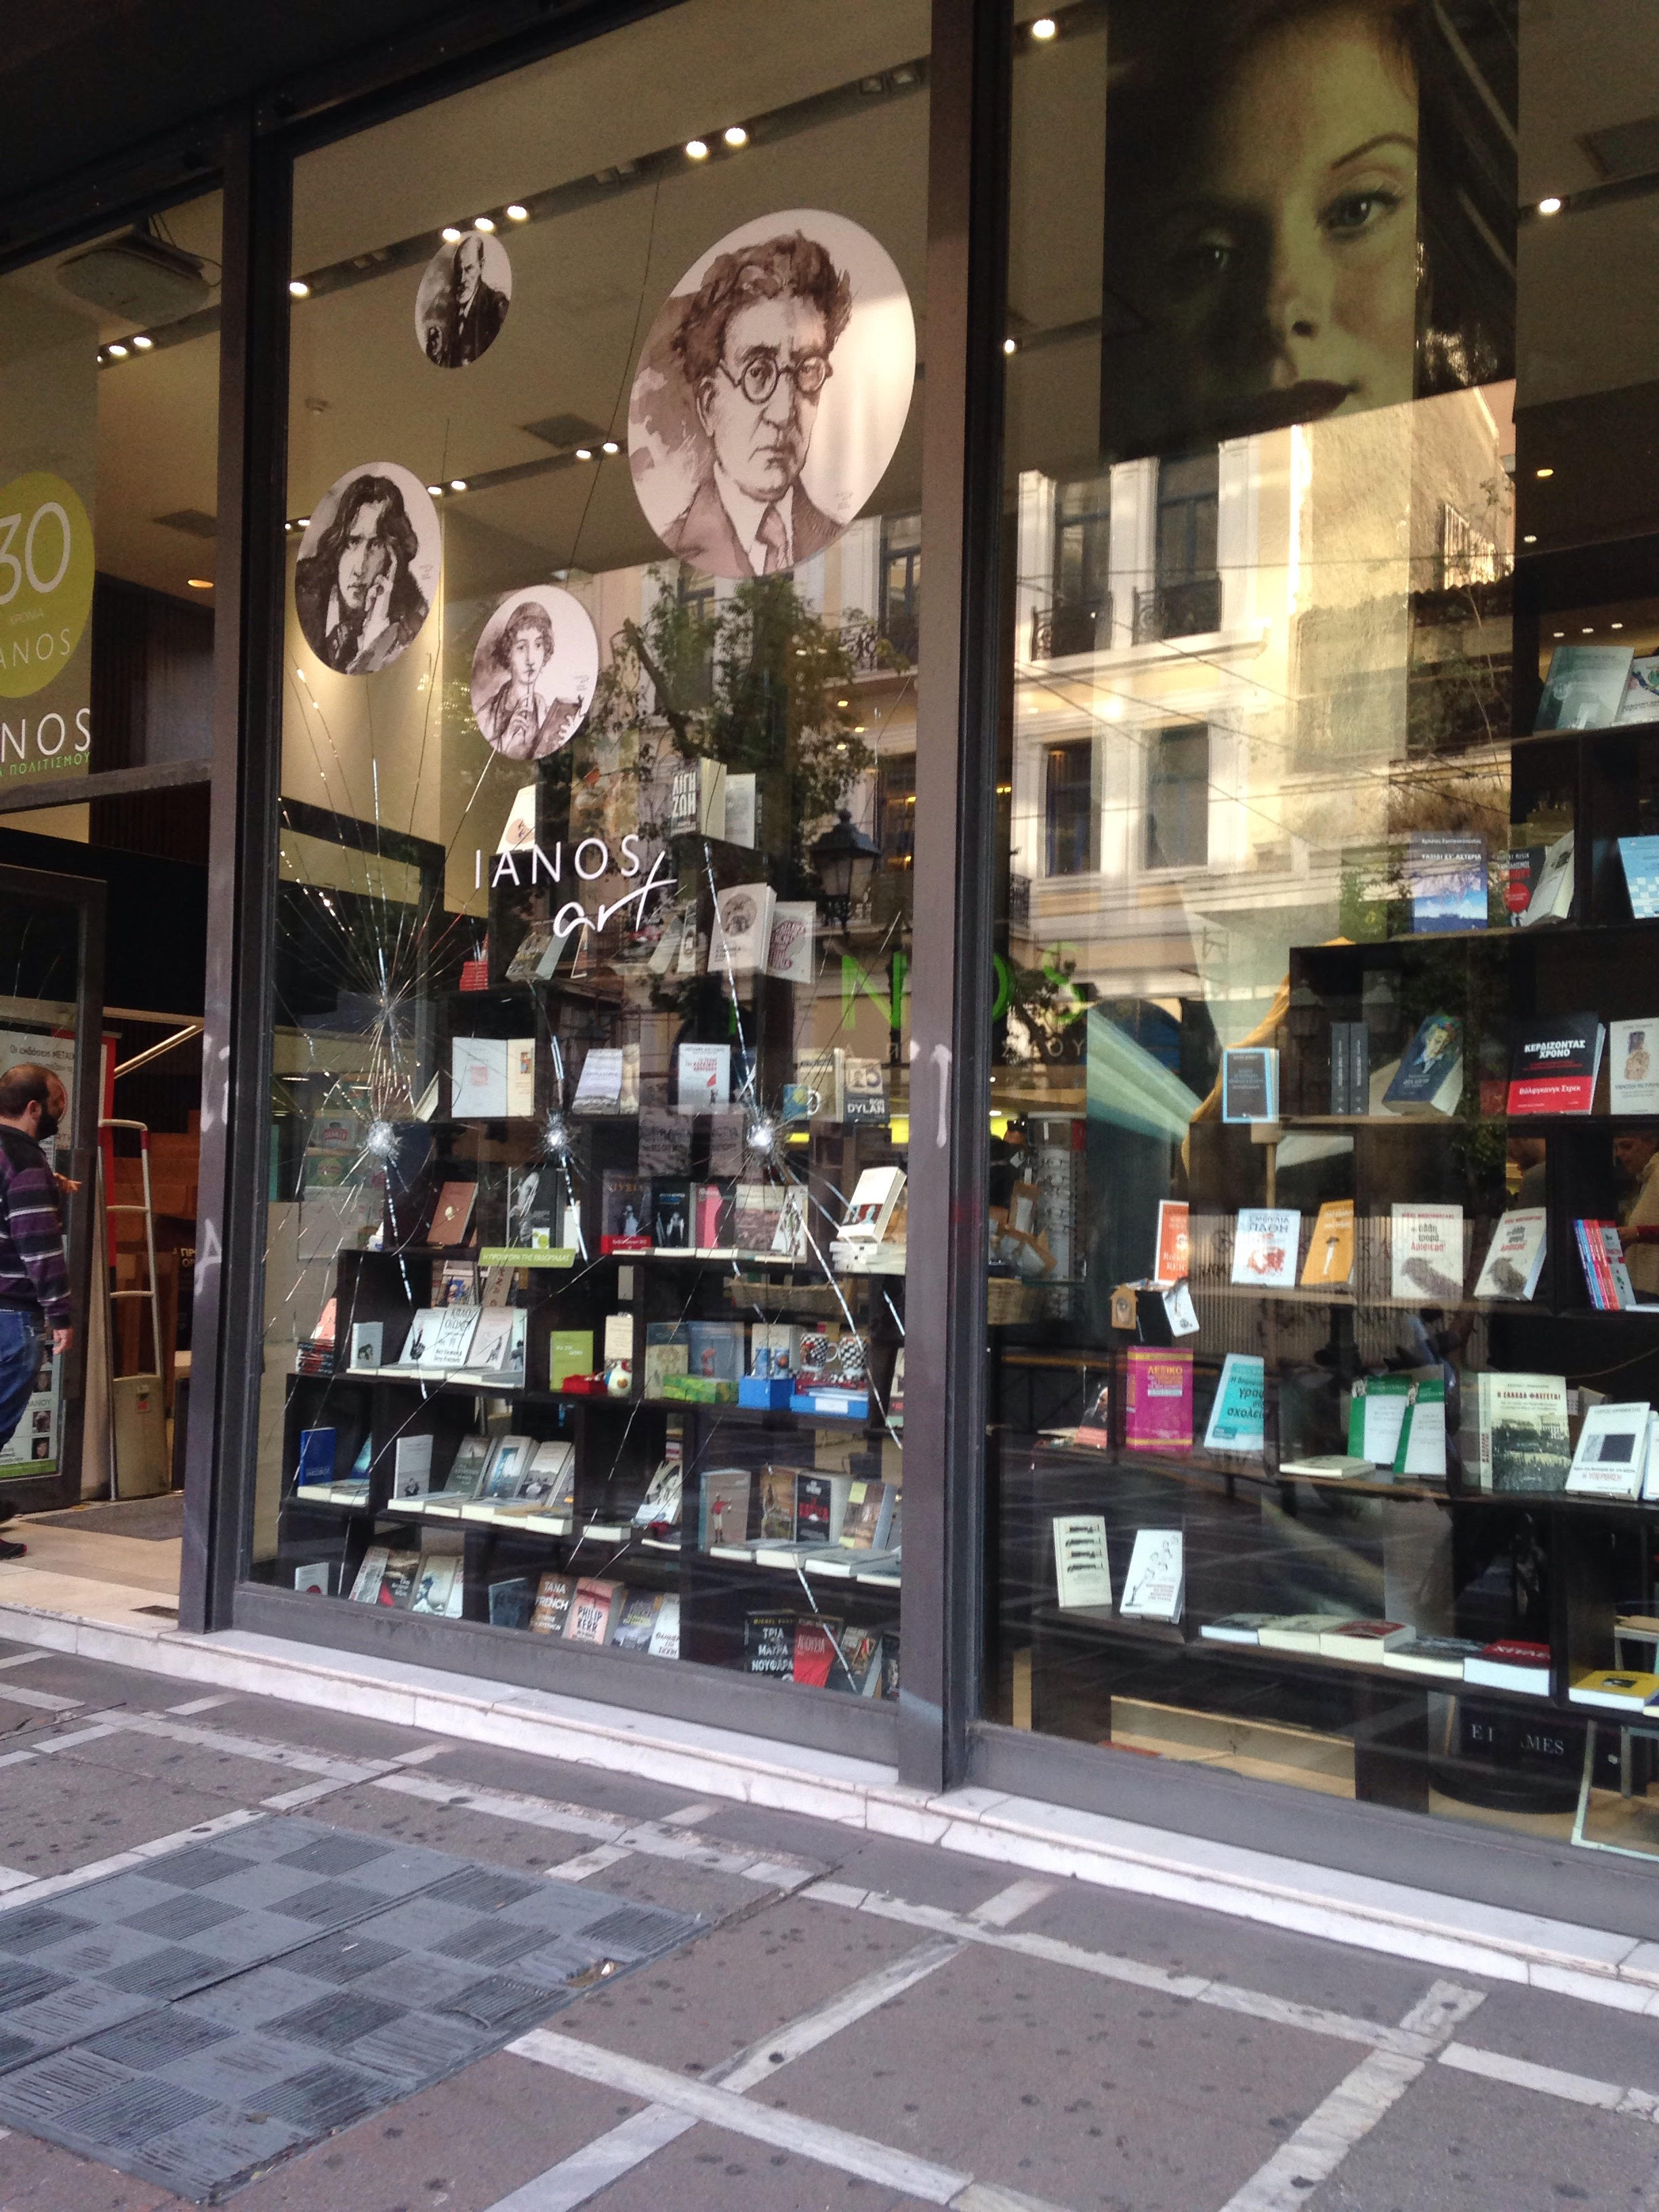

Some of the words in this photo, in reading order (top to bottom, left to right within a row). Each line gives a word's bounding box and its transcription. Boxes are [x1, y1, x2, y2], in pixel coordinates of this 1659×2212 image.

[0, 501, 71, 605] 30
[9, 751, 91, 775] ΠΟΛΙΤΙΣΜΟΥ
[475, 834, 640, 890] IANOS
[552, 850, 678, 939] art
[1524, 1040, 1586, 1053] ΚΕΡΔΙΖΟΝΤΑΣ
[1539, 1048, 1571, 1059] ΧΡΟΝΟ
[846, 1103, 884, 1115] DYLAN
[535, 1596, 569, 1612] FRENCH
[577, 1605, 602, 1622] PHILIP
[762, 1627, 784, 1640] ΤΡΙΑ
[758, 1643, 789, 1656] ΜΑΥΡΑ
